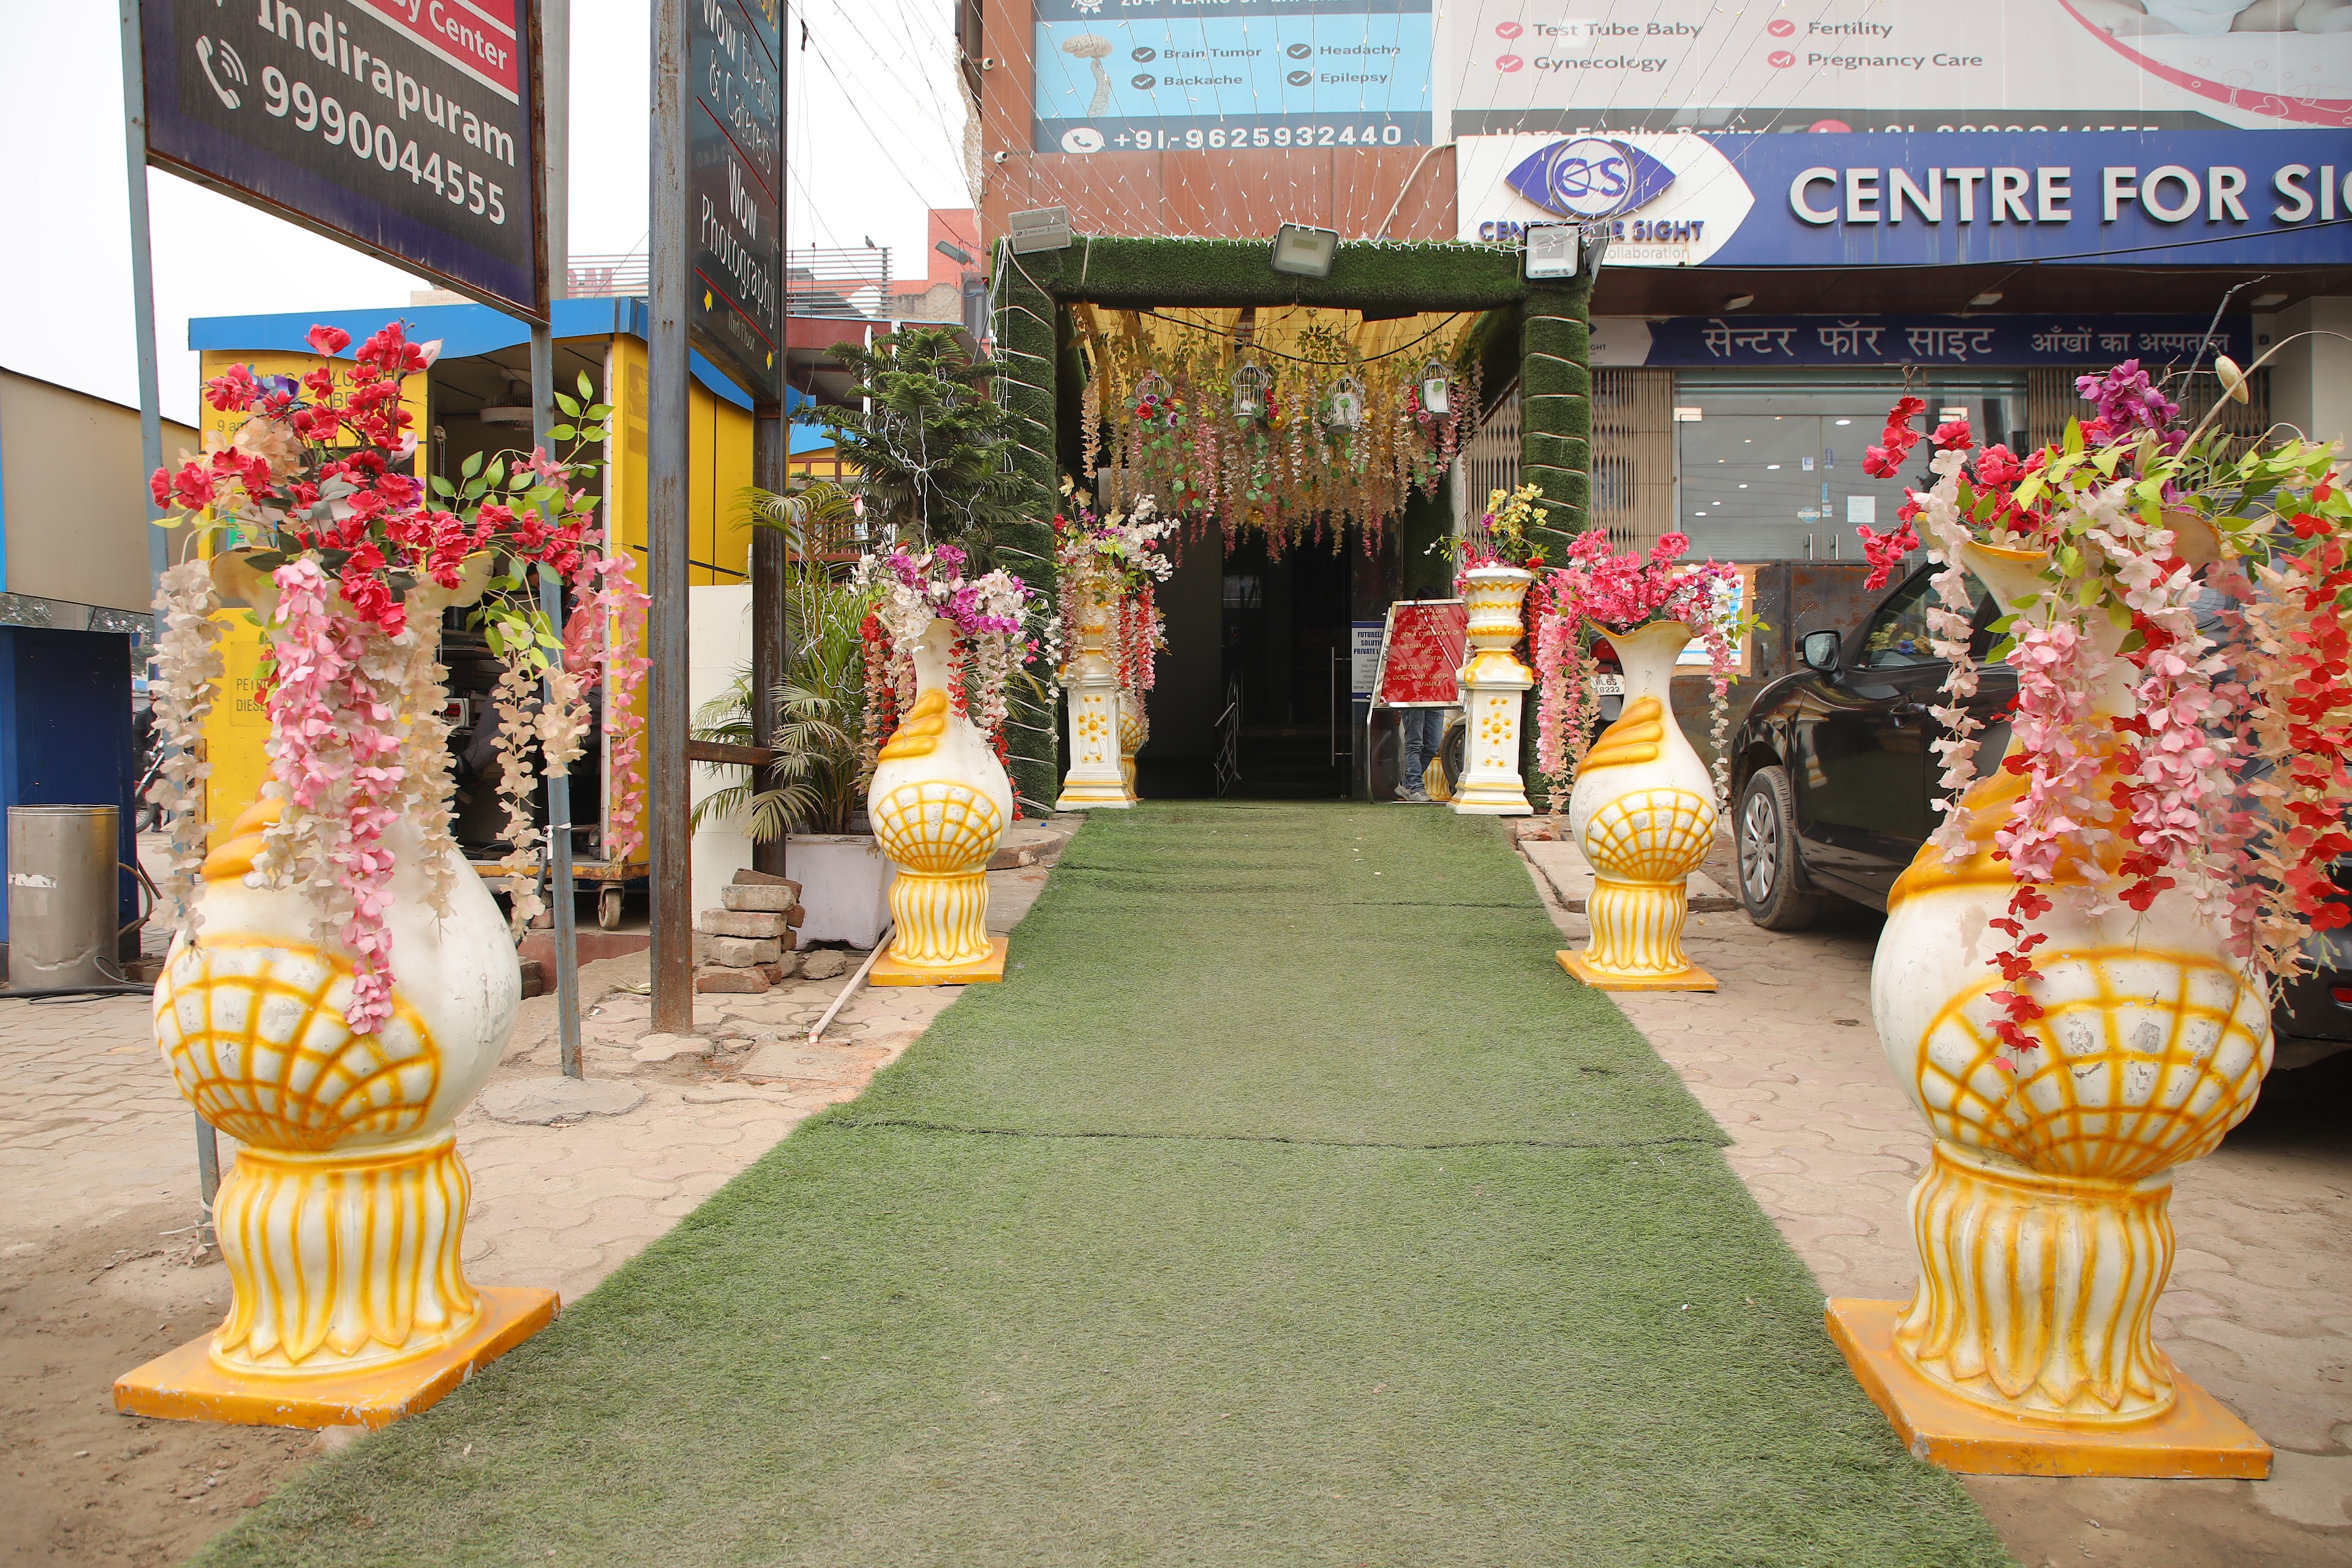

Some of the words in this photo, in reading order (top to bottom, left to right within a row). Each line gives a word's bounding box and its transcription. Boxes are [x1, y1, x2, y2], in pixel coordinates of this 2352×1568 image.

[429, 0, 508, 70] Center
[1532, 23, 1578, 37] Test
[1588, 23, 1641, 36] Tube
[1648, 22, 1702, 39] Baby
[1809, 22, 1893, 39] Fertility
[1163, 48, 1204, 59] Brain
[1209, 47, 1262, 58] Tumor
[1319, 44, 1401, 56] Headache
[704, 0, 736, 62] Wow
[742, 28, 776, 128] Events
[1534, 56, 1668, 73] Gynecology
[1808, 53, 1926, 70] Pregnancy
[1932, 53, 1983, 67] Care
[258, 0, 515, 167] Indirapuram
[1163, 74, 1243, 86] Backache
[1320, 72, 1388, 84] Epilepsy
[709, 48, 722, 104] &
[726, 71, 771, 175] Caterers
[262, 66, 506, 225] 9990044555
[728, 154, 758, 241] Wow
[1790, 167, 2072, 225] CENTRE
[2100, 164, 2250, 223] FOR
[1632, 220, 1705, 241] SIGHT
[701, 192, 775, 330] Photography
[1702, 318, 1797, 358] सेन्टर
[1817, 320, 1886, 356] फॉर
[1905, 327, 1994, 362] साइट
[2030, 325, 2092, 353] आँखों
[2098, 333, 2132, 353] का
[217, 420, 225, 432] 9
[236, 699, 266, 712] DIESE
